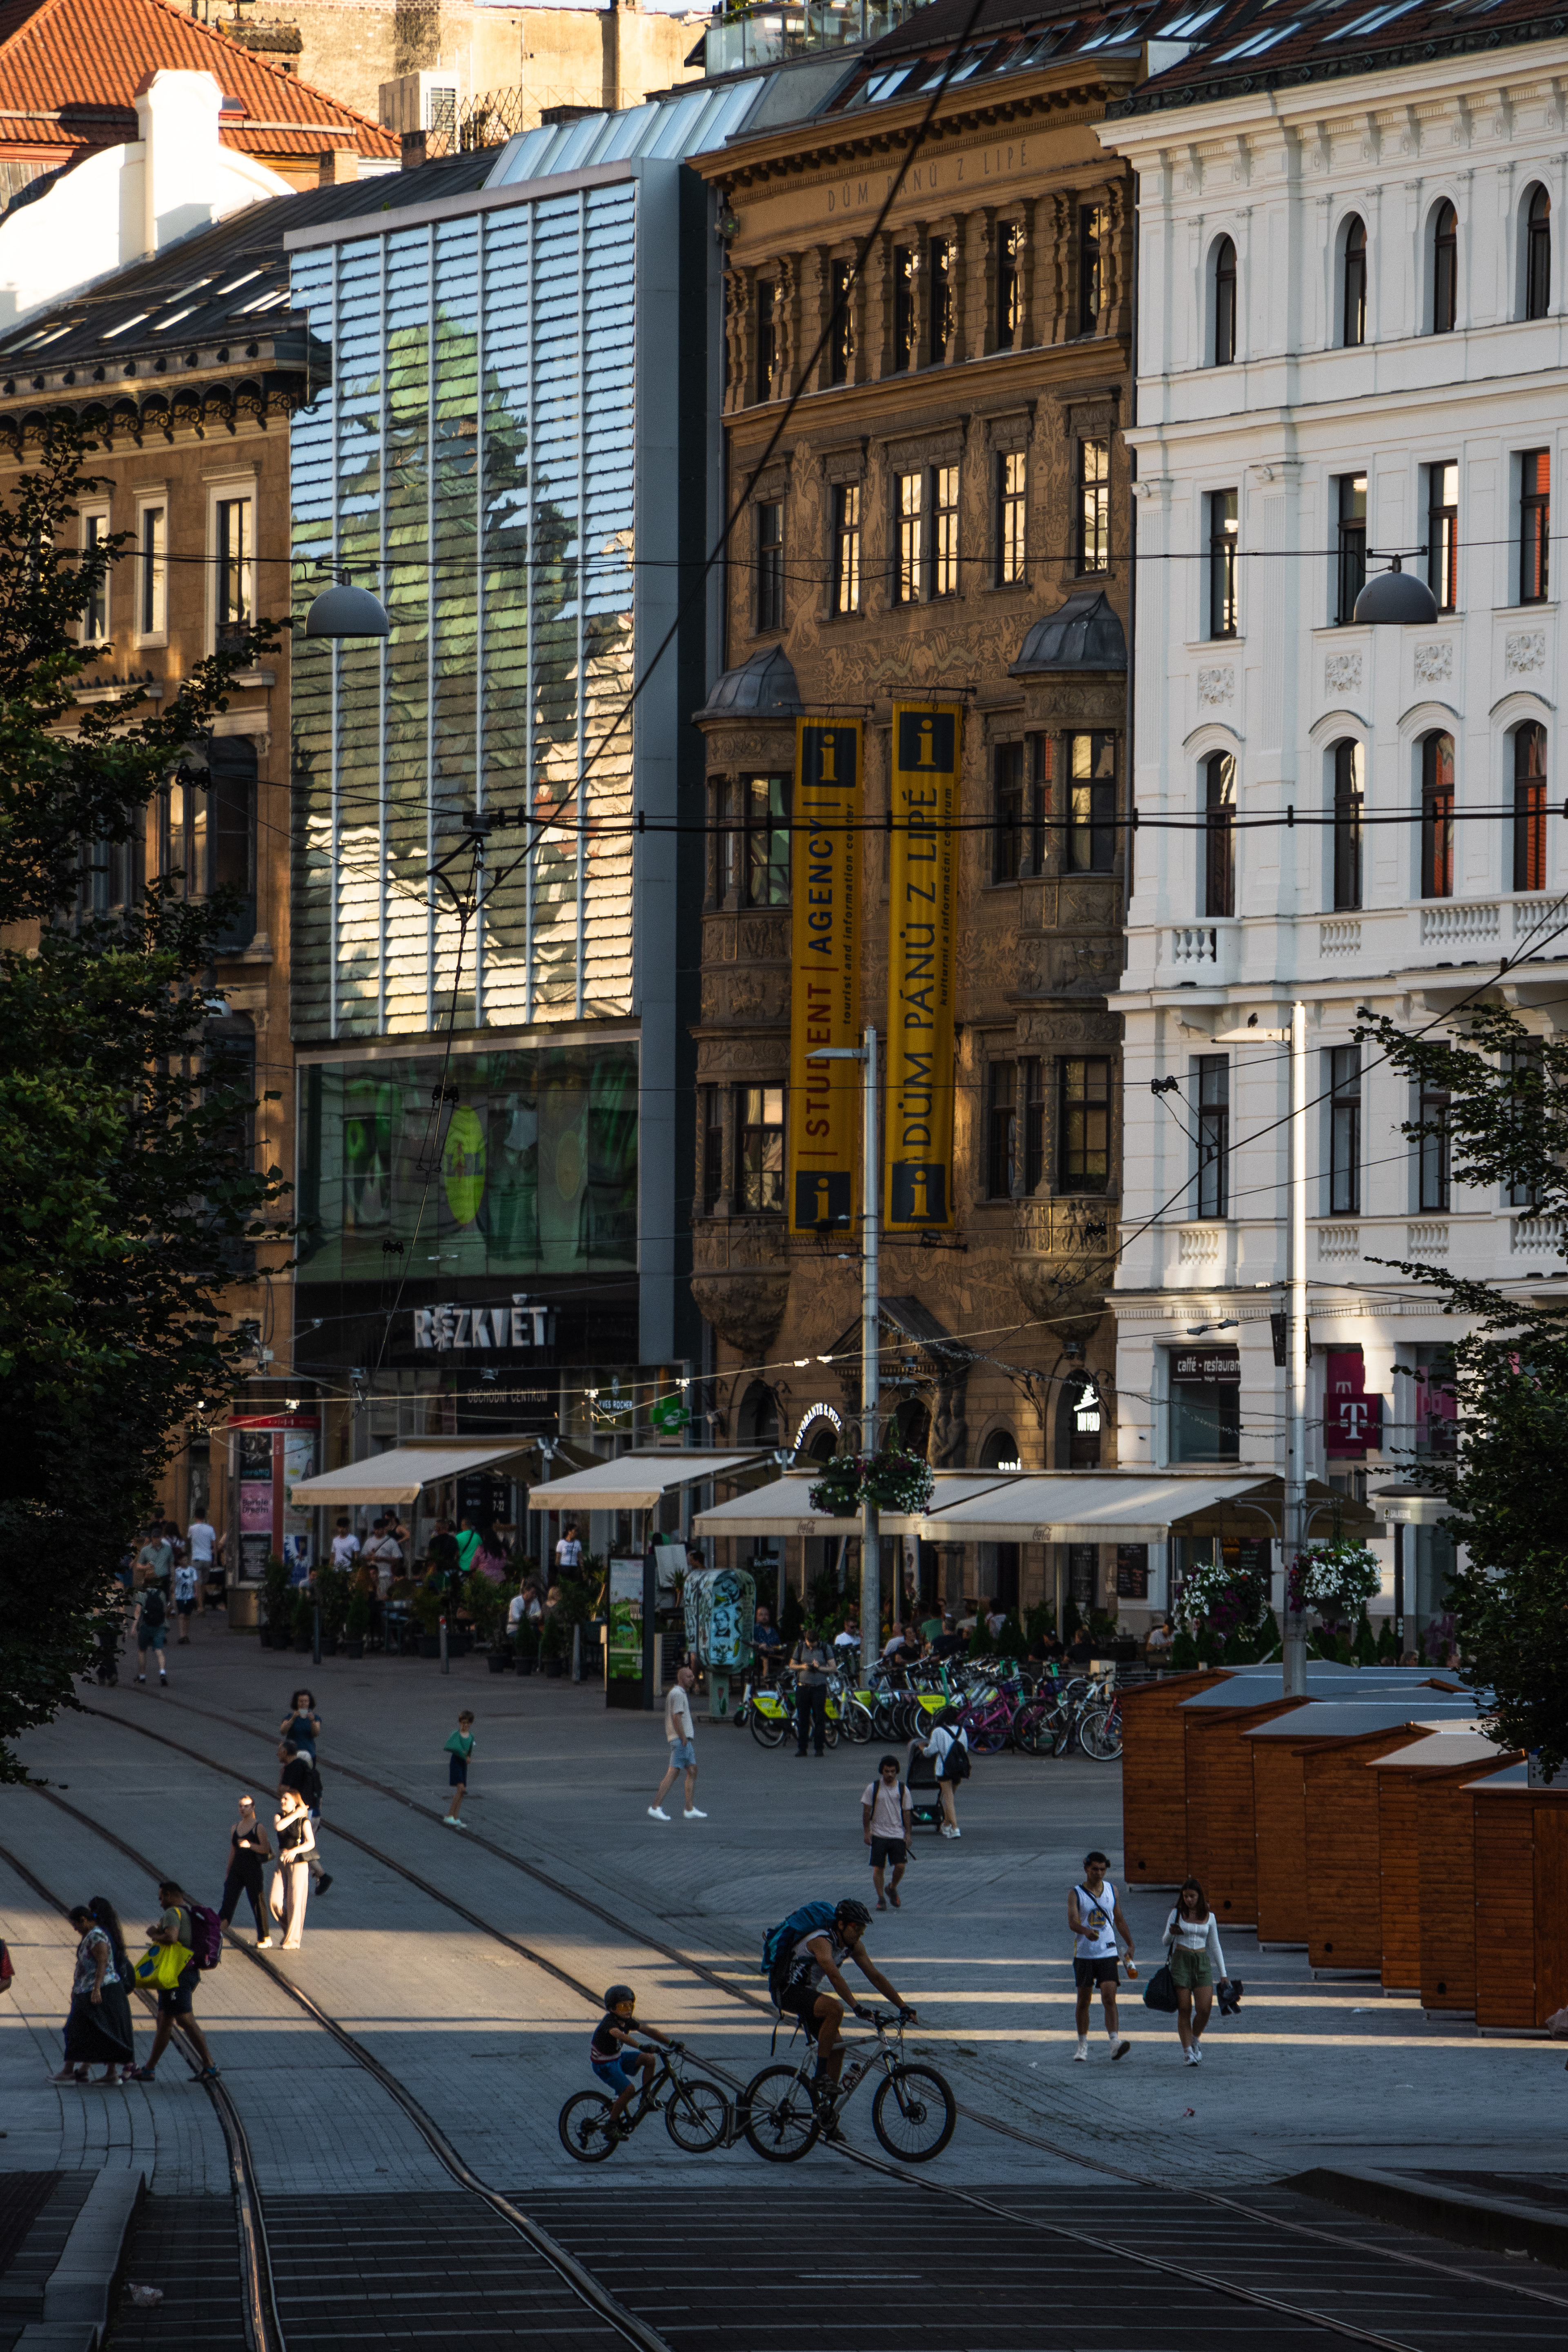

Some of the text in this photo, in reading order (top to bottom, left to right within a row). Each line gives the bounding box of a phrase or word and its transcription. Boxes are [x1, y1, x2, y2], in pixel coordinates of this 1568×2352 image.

[957, 158, 963, 180] Z
[984, 140, 1027, 175] LIPÉ
[843, 855, 853, 939] information
[940, 852, 951, 931] informační
[806, 818, 834, 1138] STUDENT AGENCY
[843, 944, 852, 970] and
[898, 788, 938, 1146] DŮM PÁNŮ Z LIPÉ
[940, 948, 949, 1006] kulturní
[842, 976, 852, 1025] tourist
[1177, 1355, 1197, 1373] caffé
[468, 1385, 548, 1403] OBCHODNÍ CENTRUM
[599, 1399, 633, 1410] YVES ROCHER
